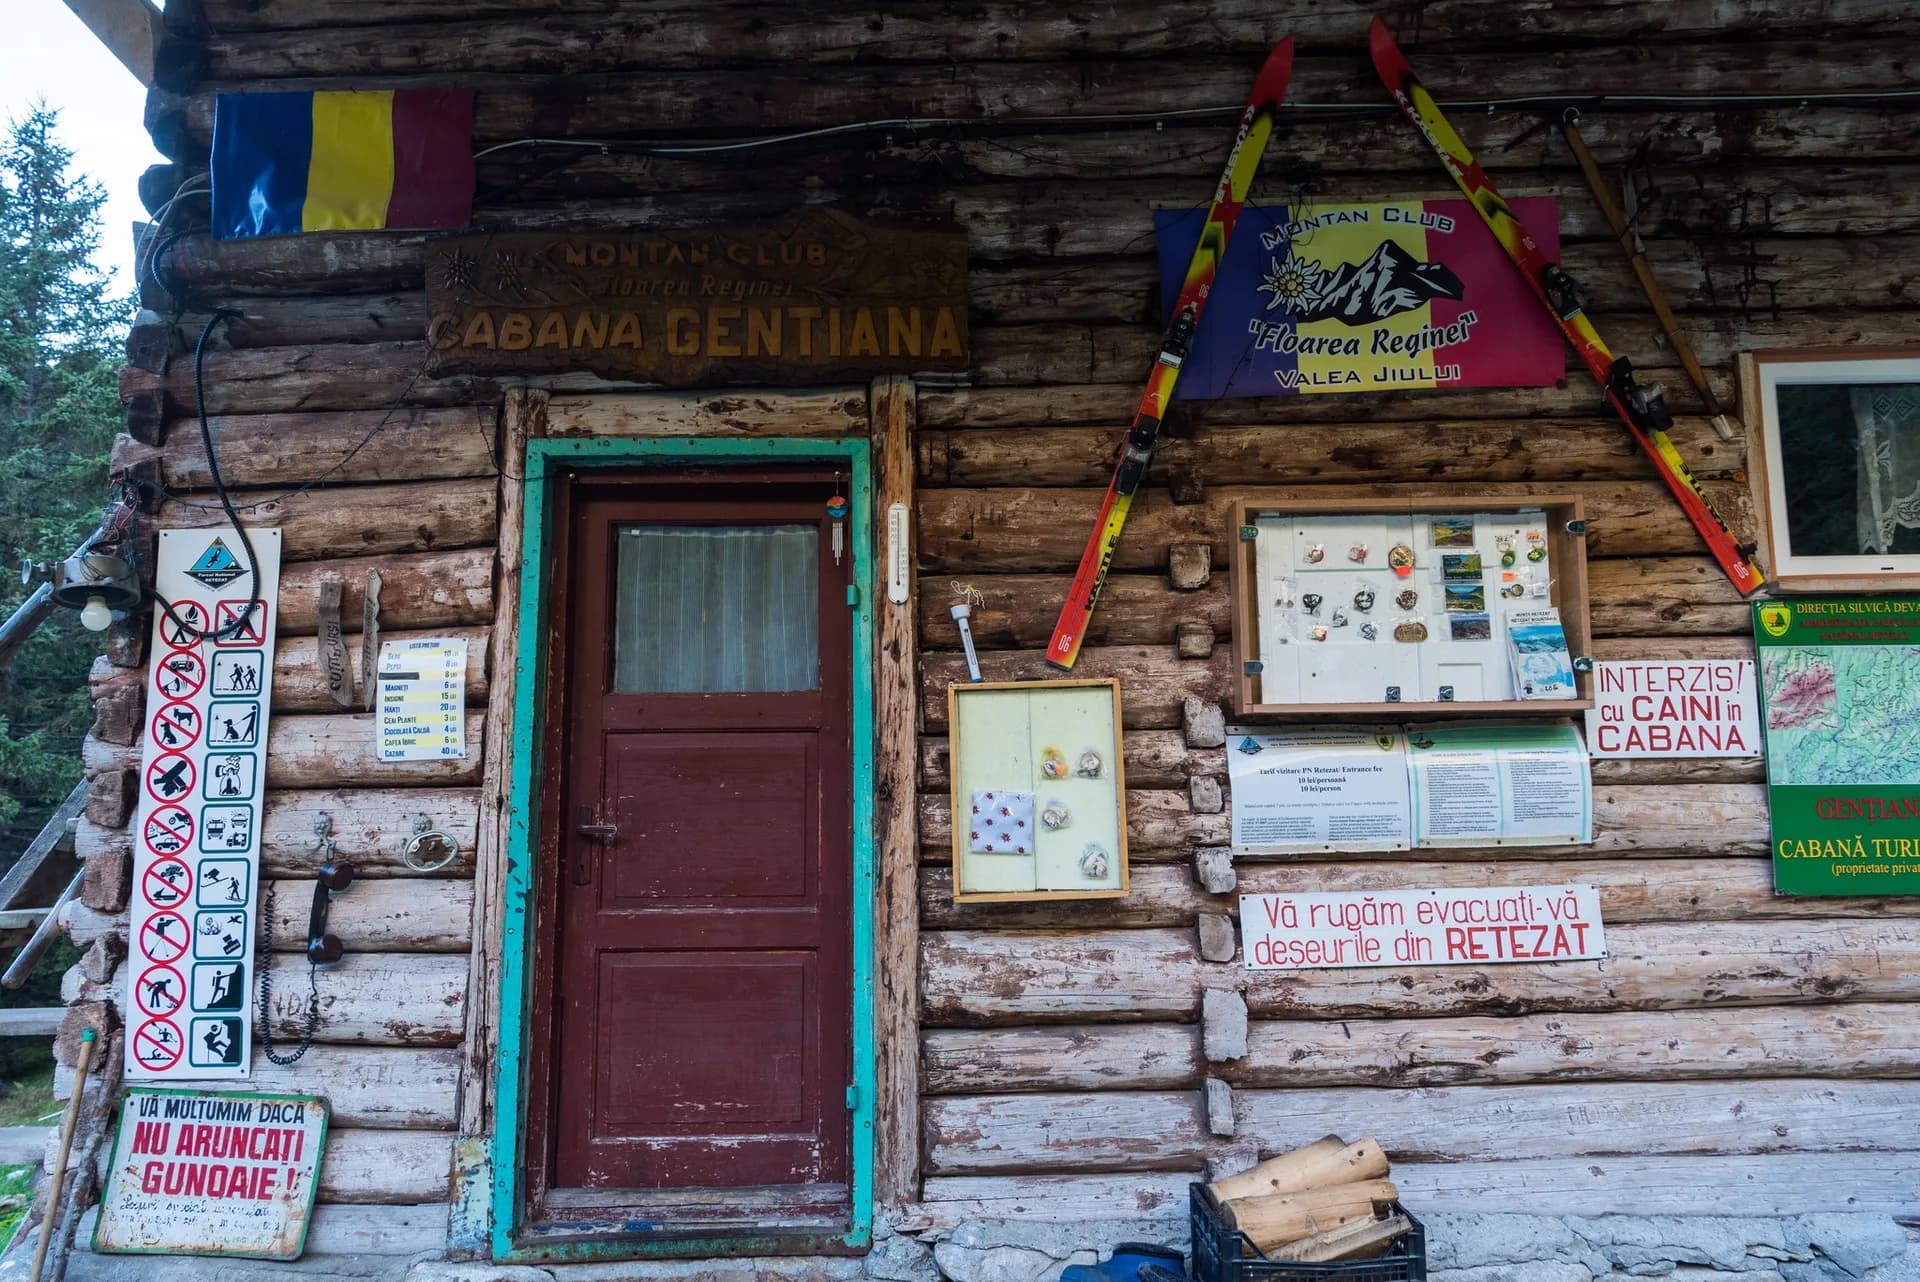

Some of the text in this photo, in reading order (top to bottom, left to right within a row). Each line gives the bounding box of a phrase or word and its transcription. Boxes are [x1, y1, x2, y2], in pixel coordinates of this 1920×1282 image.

[1261, 207, 1455, 249] MONTAN CLUB
[566, 241, 829, 268] MONTAN CLUB
[429, 307, 963, 358] CABANA GENTIANA
[1276, 365, 1461, 387] VALEA JIULUI
[1601, 703, 1624, 722] cu
[1631, 695, 1721, 722] CAINI
[441, 747, 449, 755] 40
[1598, 725, 1747, 752] CABANA
[1779, 834, 1868, 858] CABANĂ
[1262, 897, 1299, 929] Vă
[1311, 897, 1403, 932] rugăm
[1393, 930, 1432, 962] din
[1445, 923, 1590, 961] RETEZAT
[132, 1121, 171, 1155] NU
[141, 1161, 278, 1200] GUNOAIE
